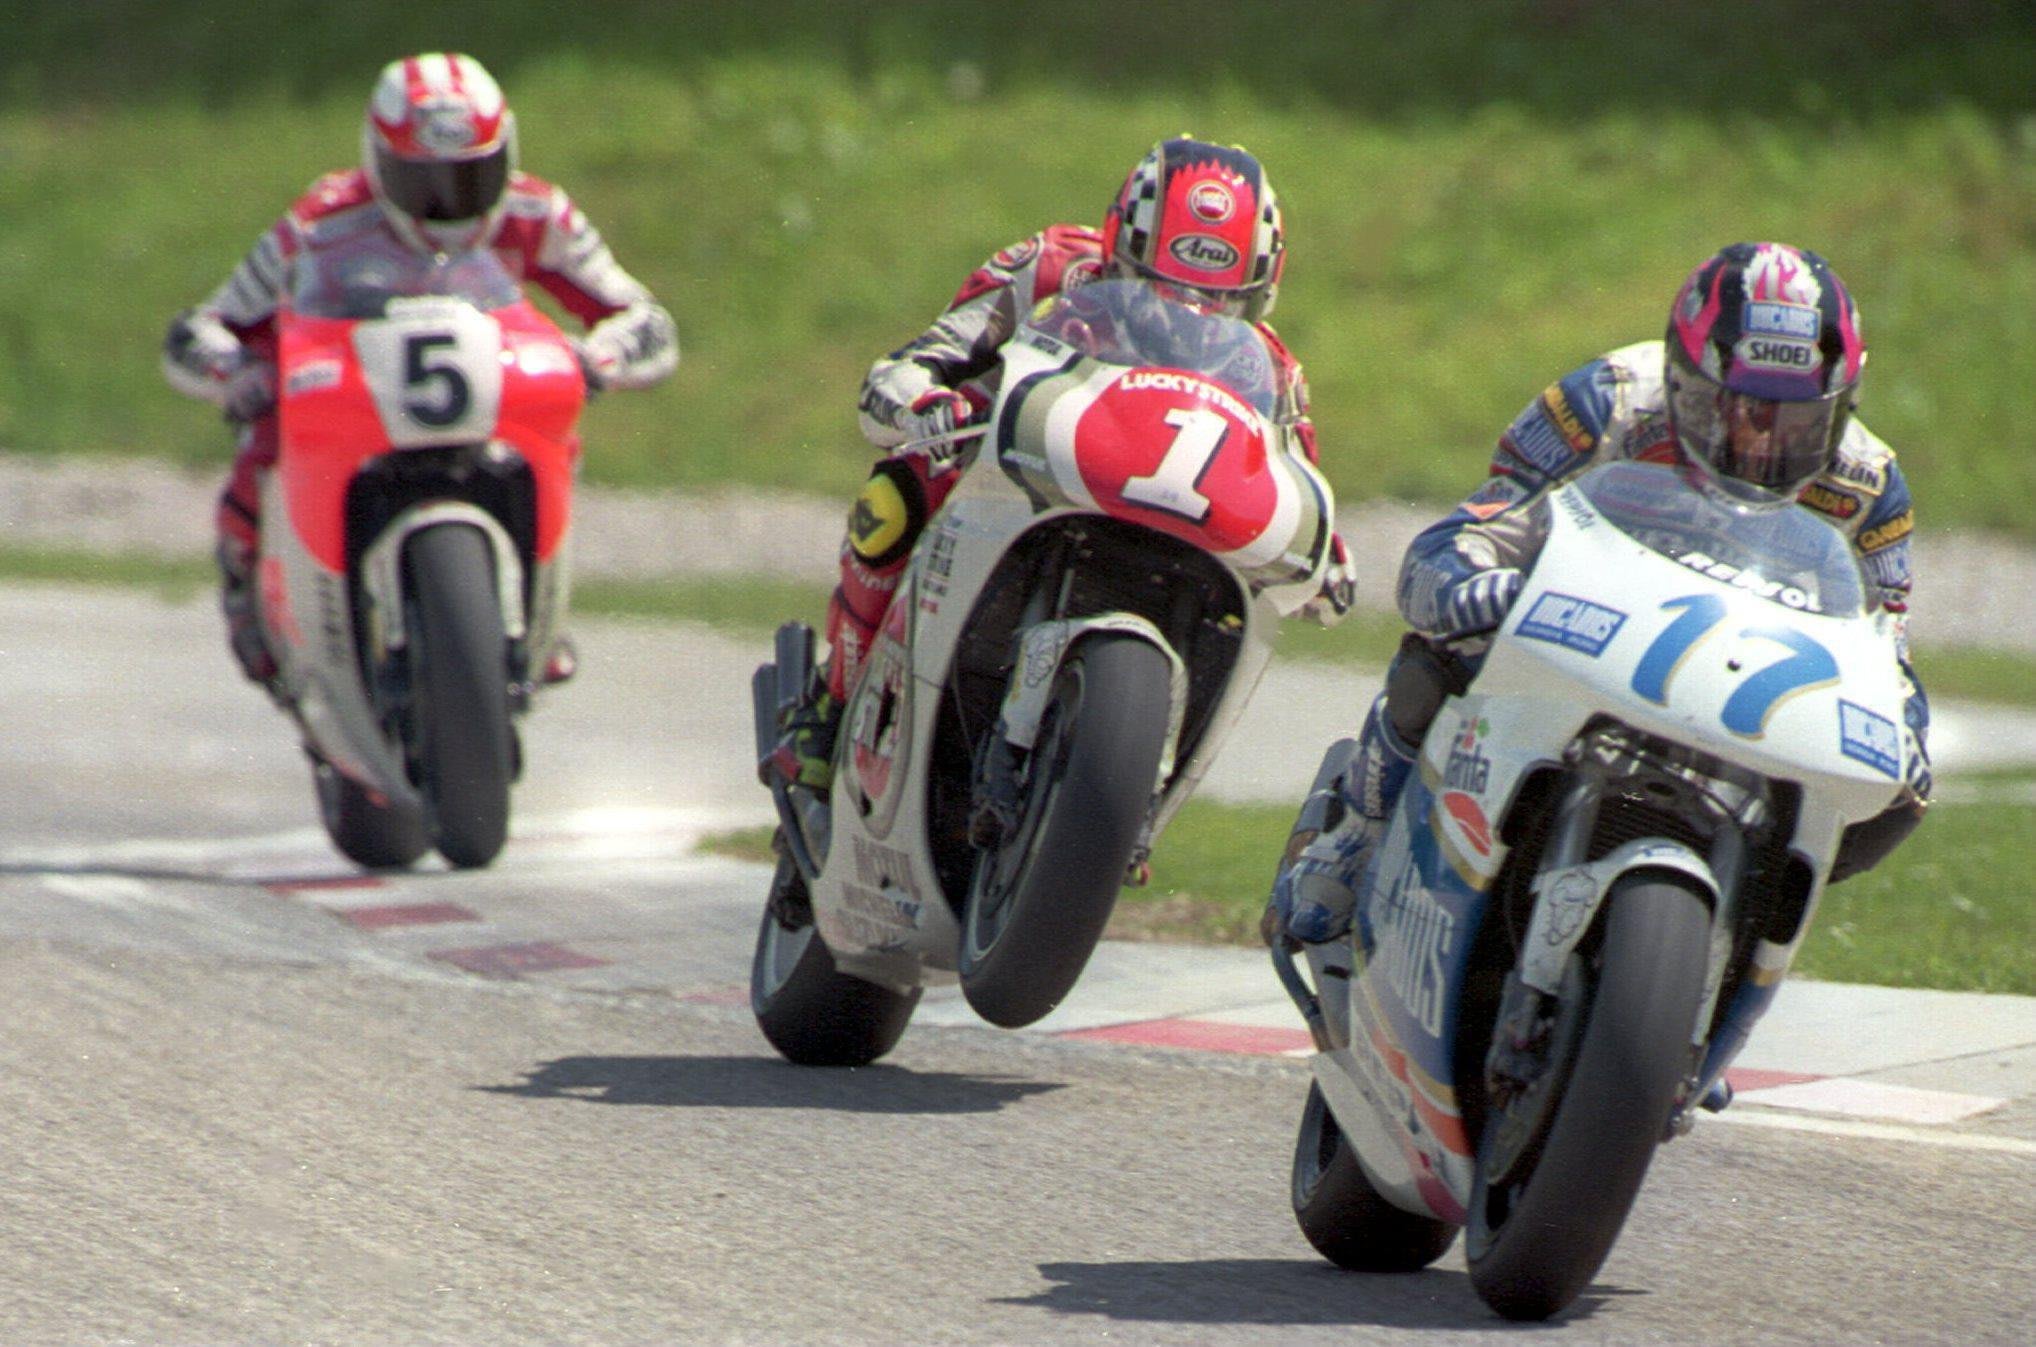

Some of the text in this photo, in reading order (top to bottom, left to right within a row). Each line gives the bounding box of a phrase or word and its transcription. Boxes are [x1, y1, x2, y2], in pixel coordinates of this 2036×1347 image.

[1180, 237, 1229, 263] Arai
[405, 334, 469, 427] 5
[1119, 371, 1198, 395] LUCKY
[1750, 341, 1811, 367] SHOEI
[1120, 407, 1228, 525] 1
[1630, 592, 1842, 742] 17
